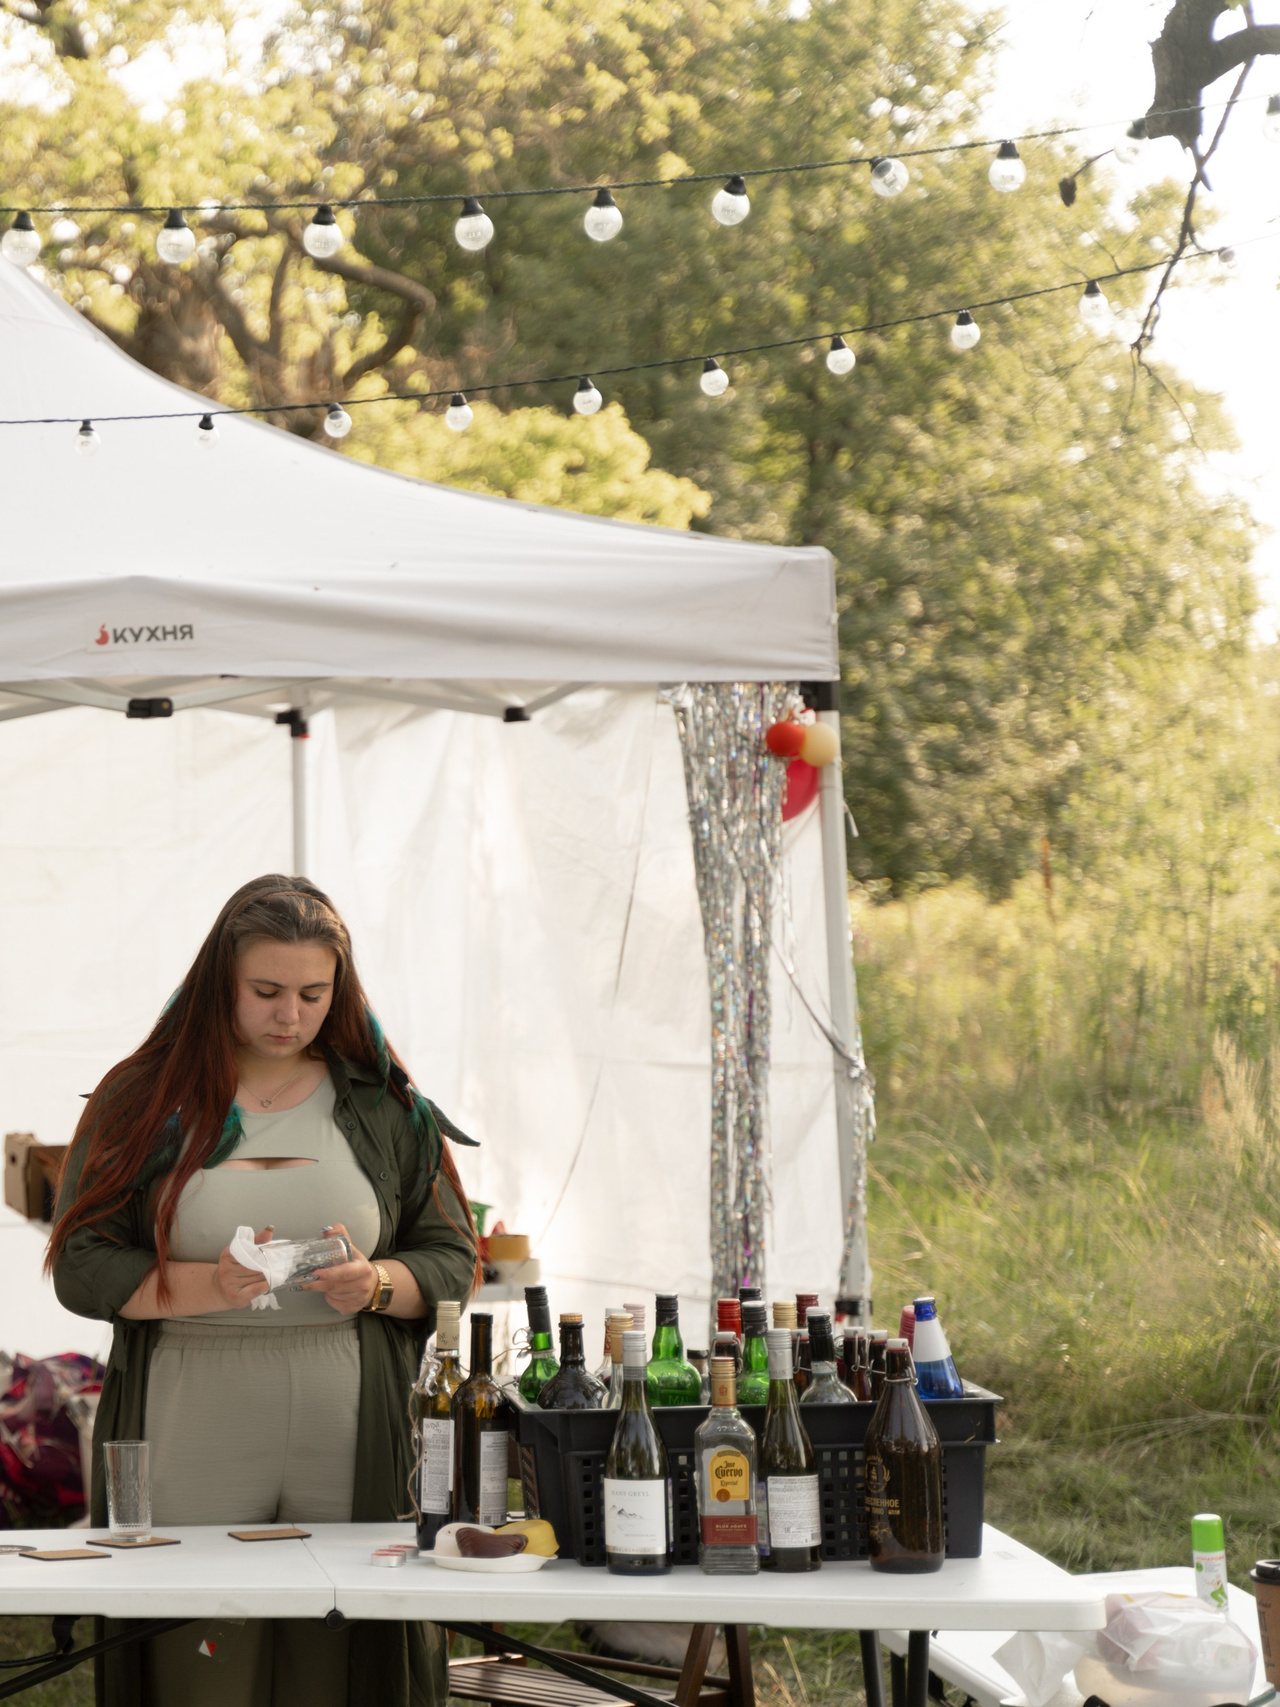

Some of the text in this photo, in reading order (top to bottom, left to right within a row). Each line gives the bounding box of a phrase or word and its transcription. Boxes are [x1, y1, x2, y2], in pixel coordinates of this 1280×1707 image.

[113, 624, 194, 644] КУХНЯ
[715, 1465, 743, 1479] Cuervo
[724, 1461, 736, 1469] Jose
